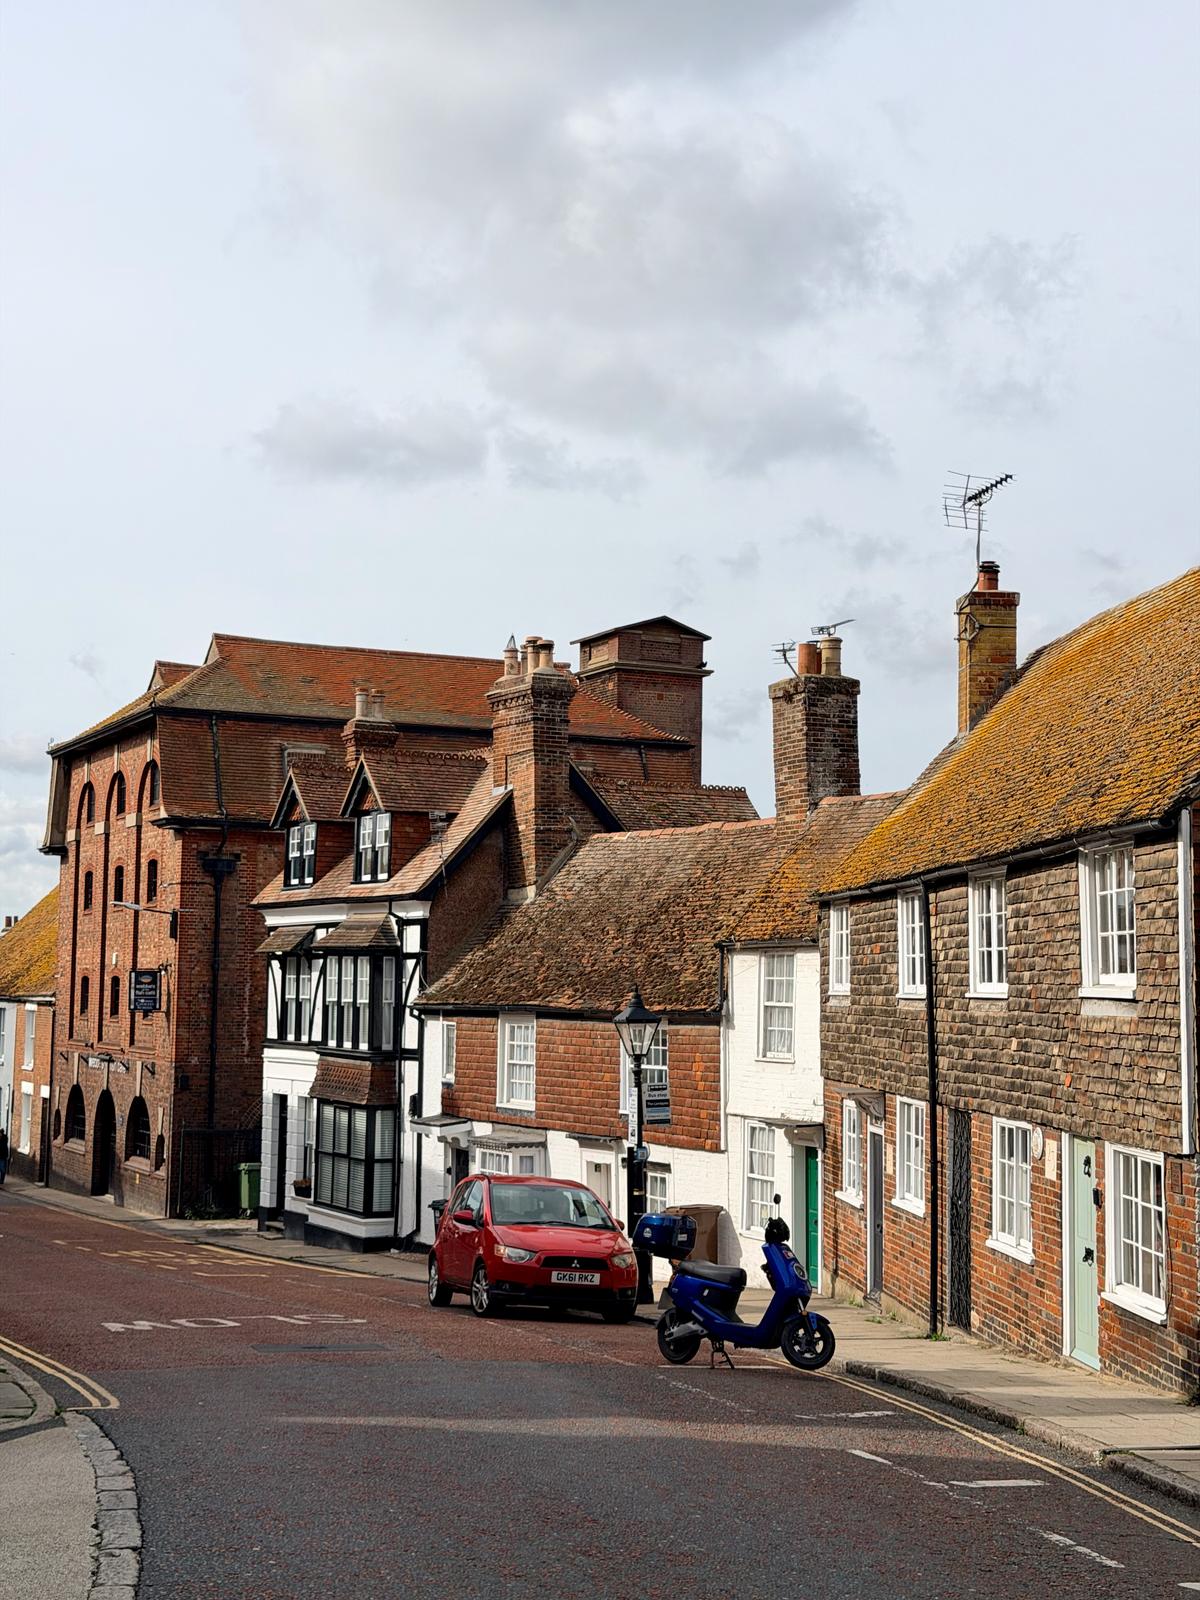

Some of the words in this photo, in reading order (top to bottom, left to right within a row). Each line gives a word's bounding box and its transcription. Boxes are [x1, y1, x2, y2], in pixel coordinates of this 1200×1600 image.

[556, 1272, 577, 1282] GK61
[578, 1273, 595, 1283] RKZ
[101, 1313, 367, 1332] SLOW
